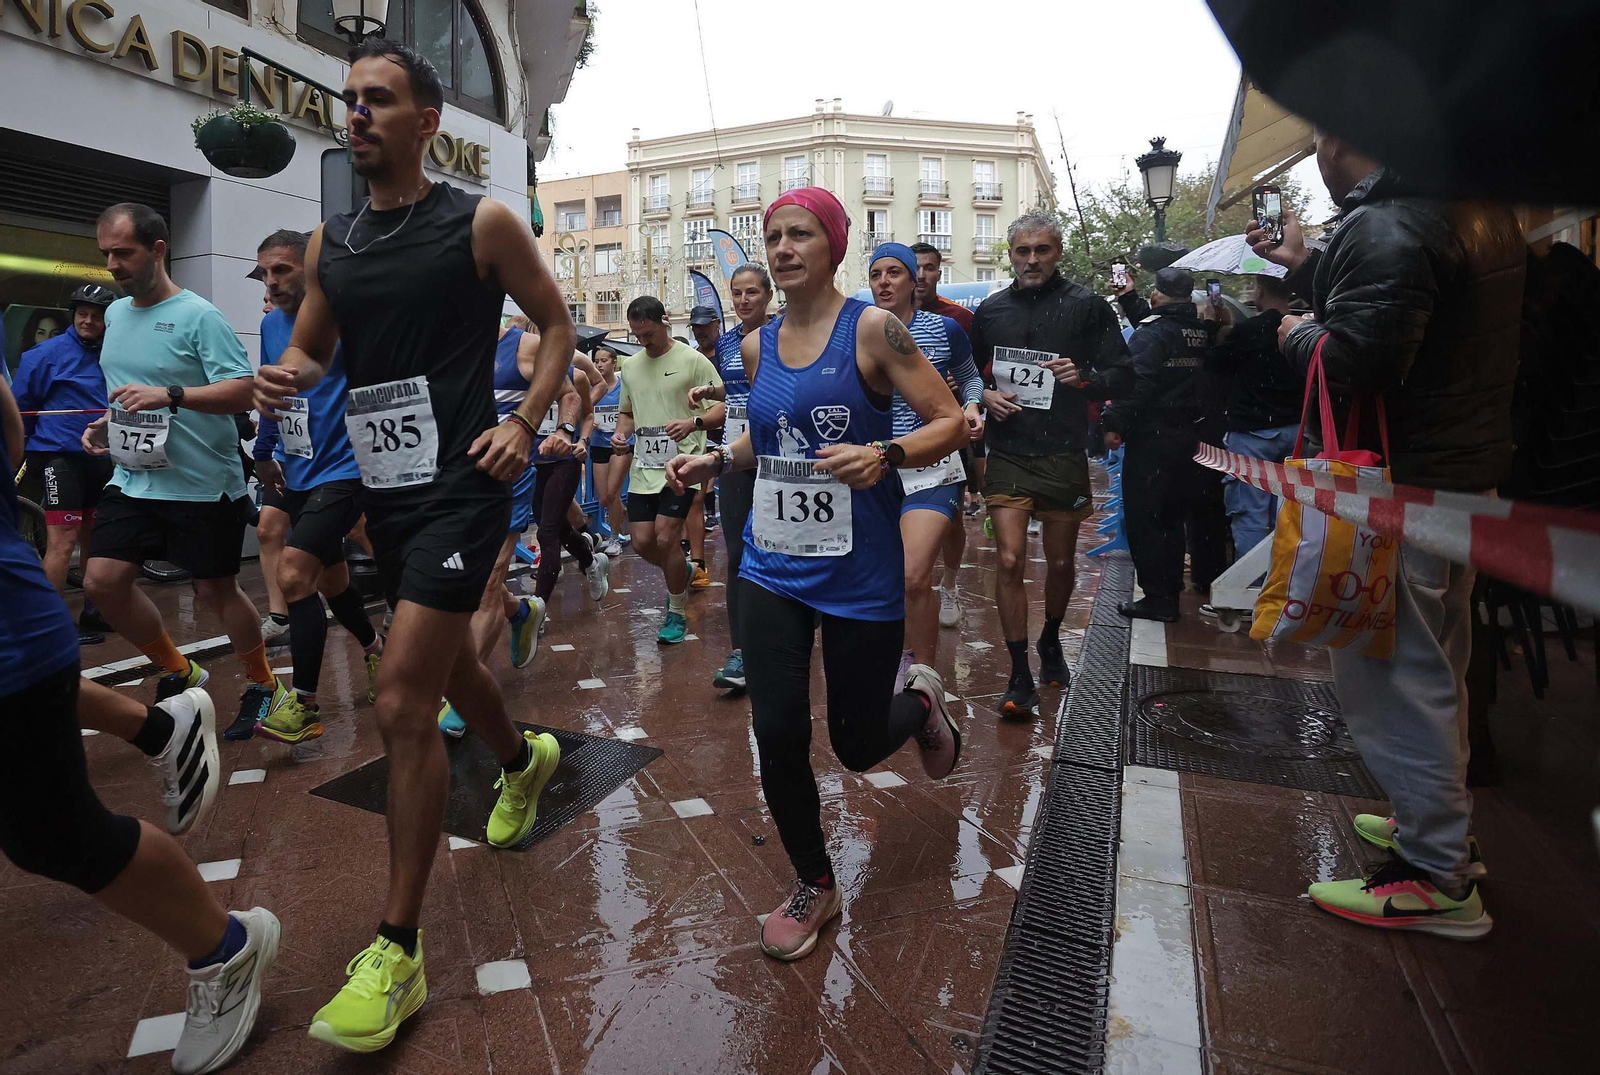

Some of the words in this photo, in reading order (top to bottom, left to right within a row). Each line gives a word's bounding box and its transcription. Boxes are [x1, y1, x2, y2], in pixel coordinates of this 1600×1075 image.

[172, 29, 347, 131] DENTAL
[422, 130, 490, 180] OKE
[1009, 366, 1044, 389] 124
[120, 429, 157, 454] 275
[366, 414, 422, 453] 285
[644, 439, 669, 454] 247
[774, 489, 835, 523] 138
[1359, 532, 1393, 550] YOU
